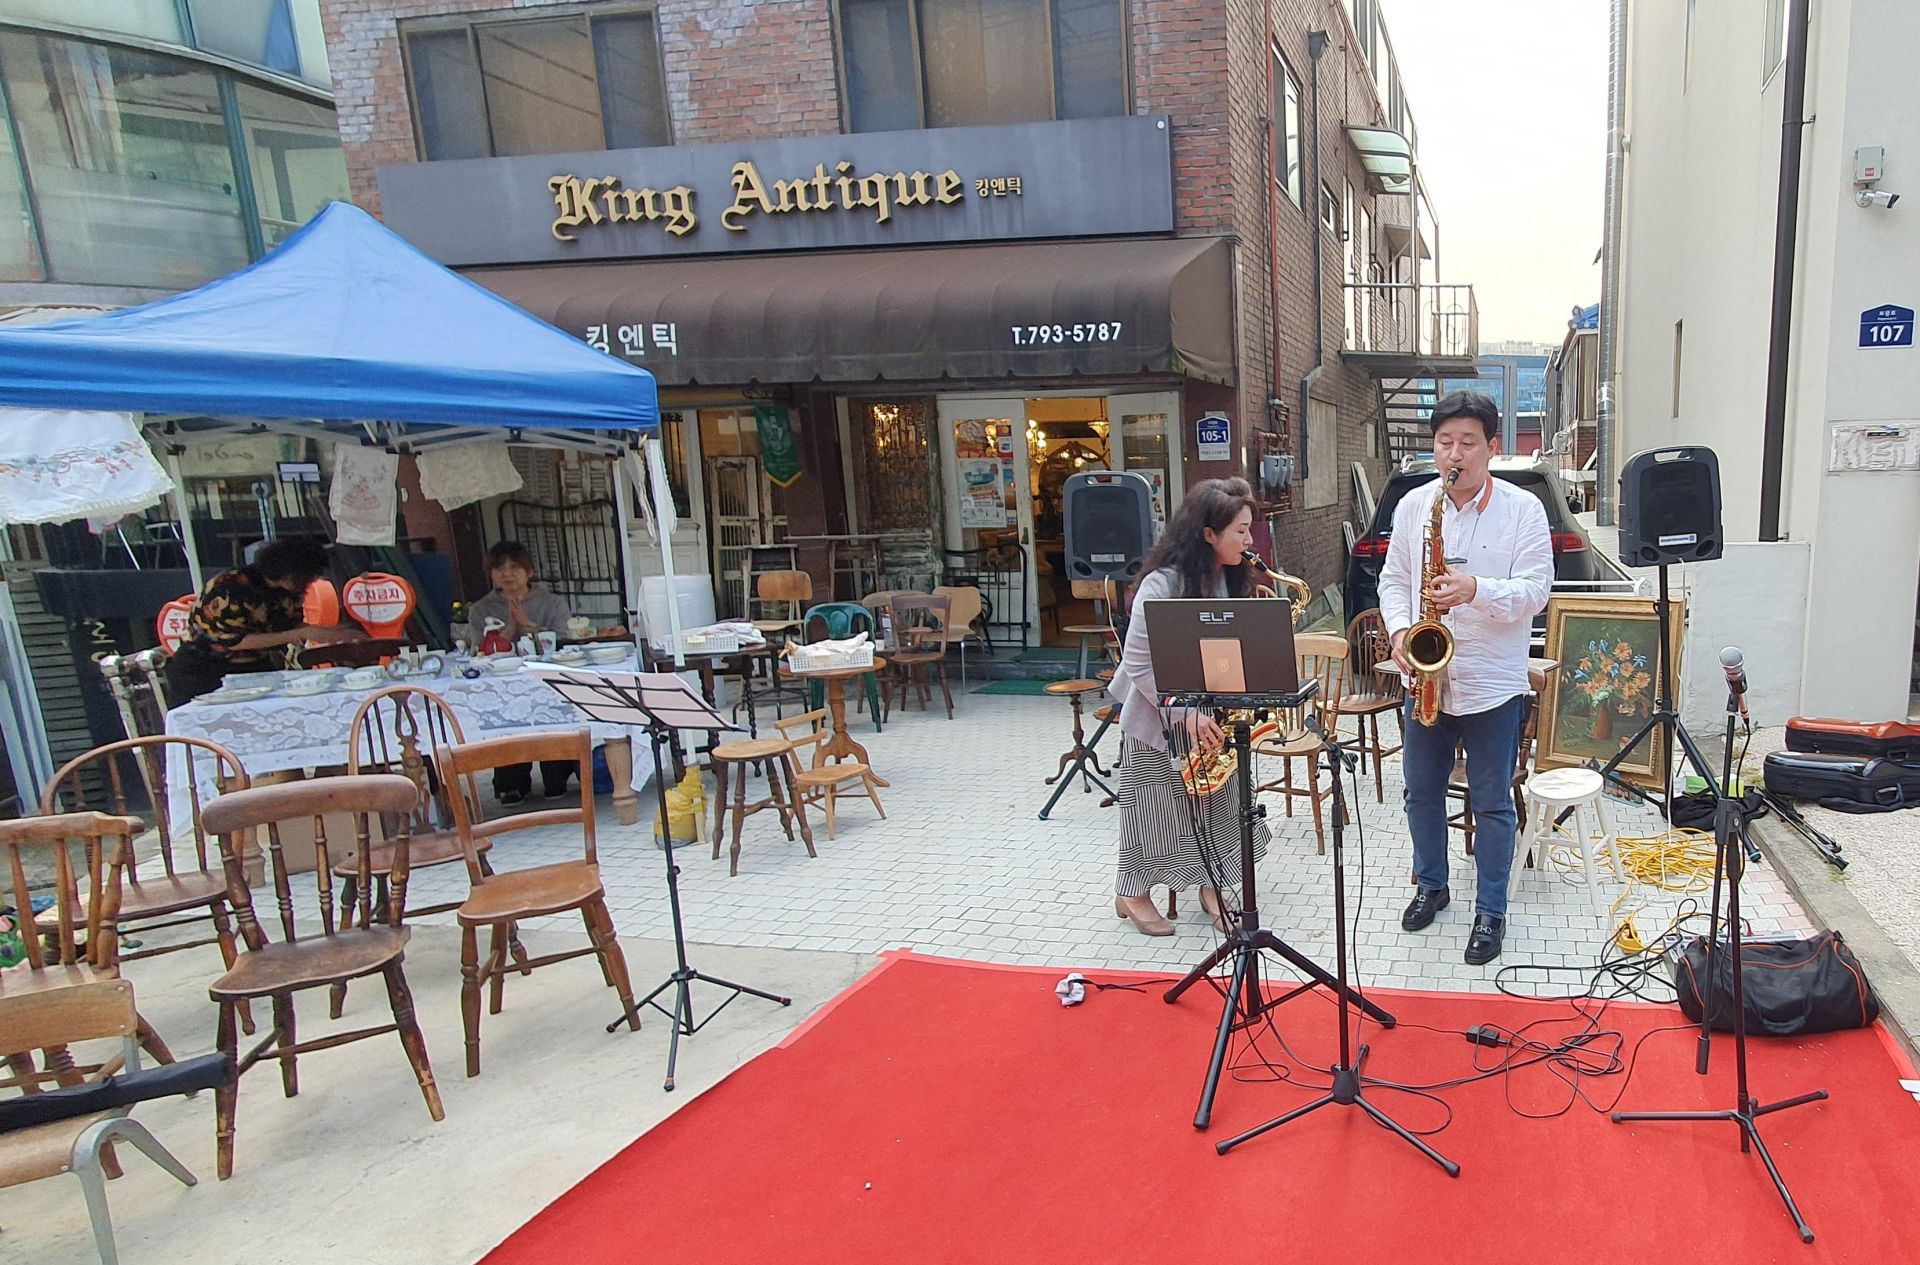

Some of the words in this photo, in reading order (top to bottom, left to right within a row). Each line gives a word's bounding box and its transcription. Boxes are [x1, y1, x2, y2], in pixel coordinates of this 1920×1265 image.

[975, 177, 1022, 198] 킹앤틱
[547, 174, 698, 241] King
[720, 161, 964, 232] Antique
[1011, 322, 1122, 345] T.793-5787
[1869, 325, 1905, 343] 107
[1201, 430, 1227, 442] 105-1
[1199, 611, 1235, 622] ELF
